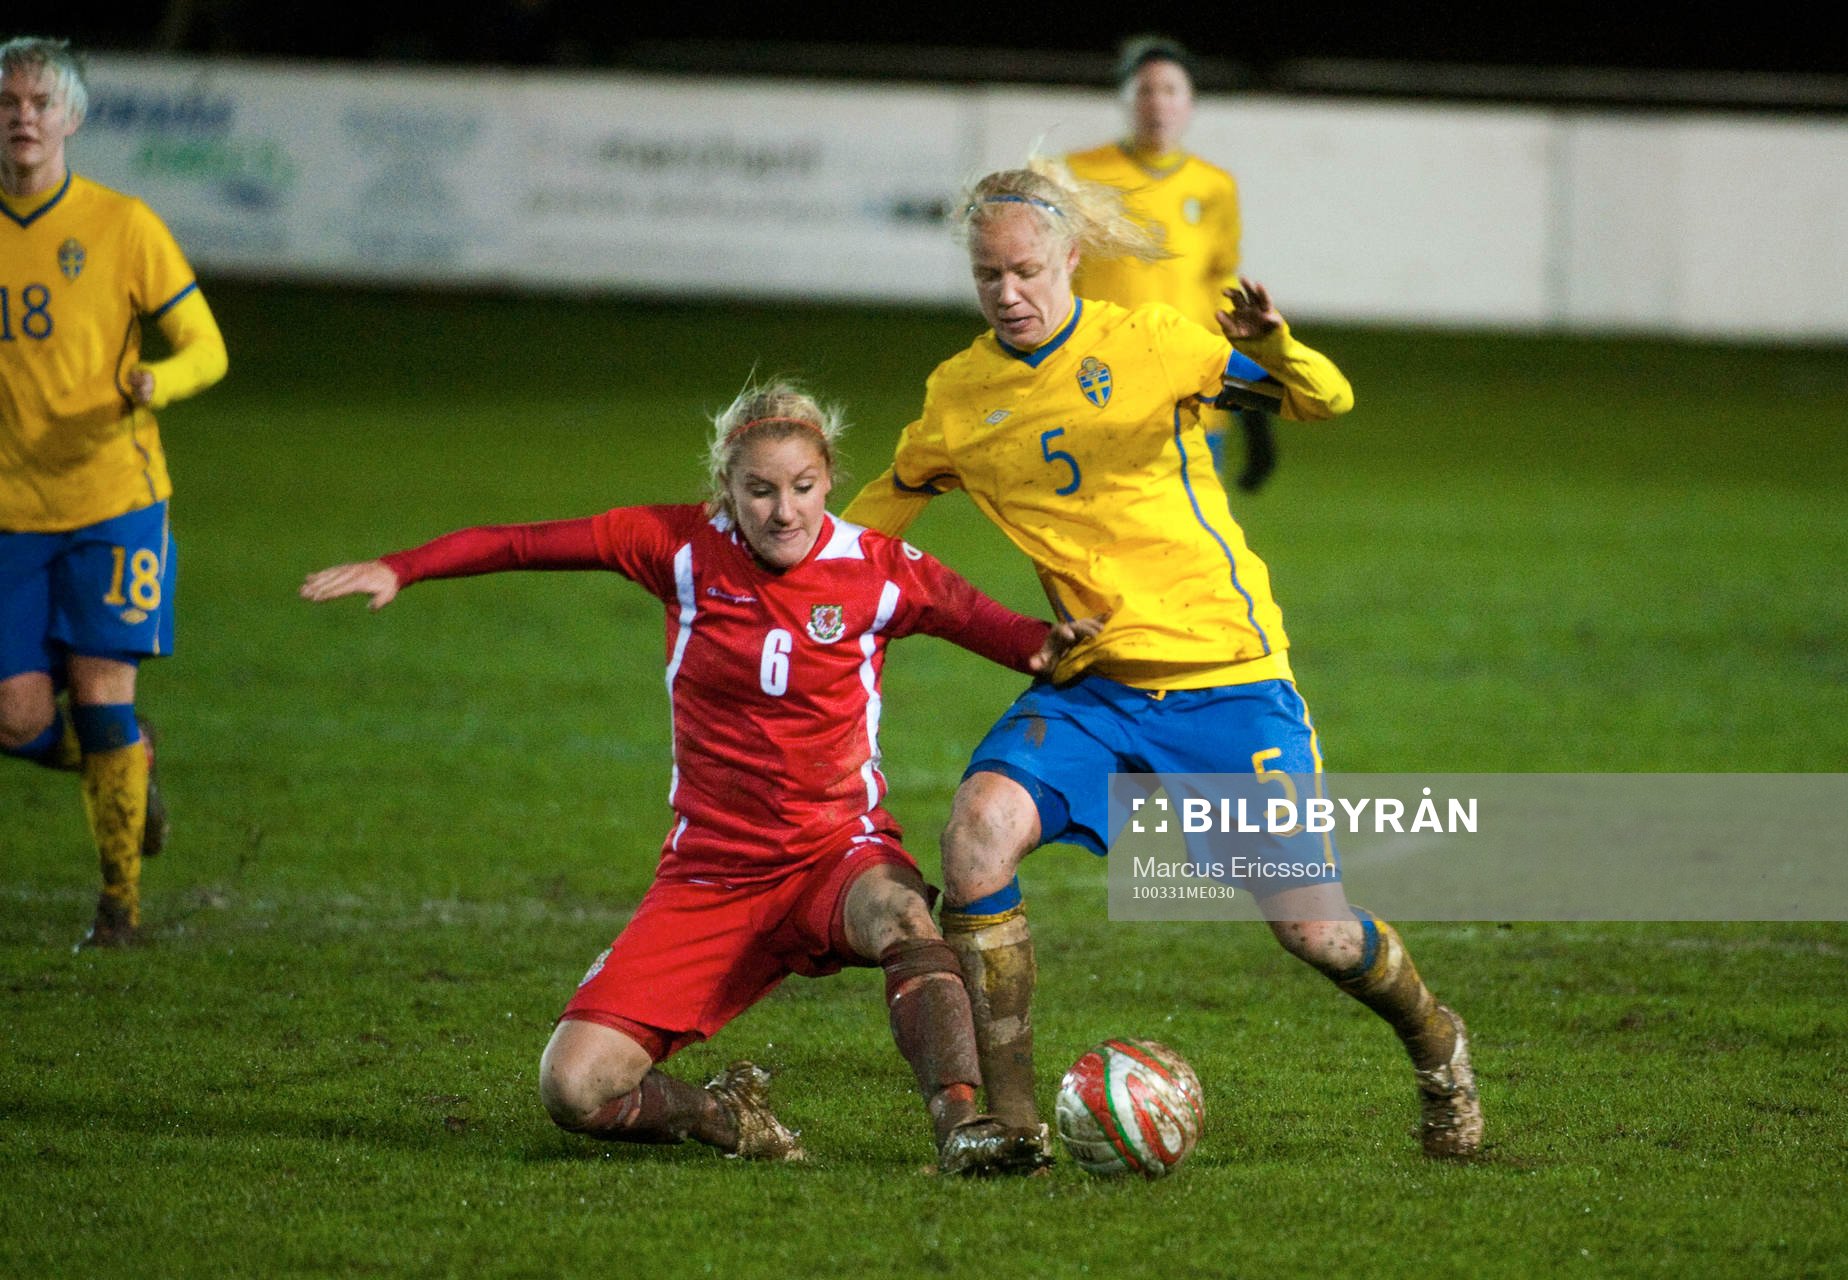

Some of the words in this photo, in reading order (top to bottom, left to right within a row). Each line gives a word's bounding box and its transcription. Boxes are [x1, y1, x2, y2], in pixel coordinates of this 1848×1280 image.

[0, 284, 54, 341] 18
[1040, 427, 1082, 496] 5
[103, 546, 162, 611] 18
[760, 628, 793, 697] 6
[1251, 747, 1298, 820] 5
